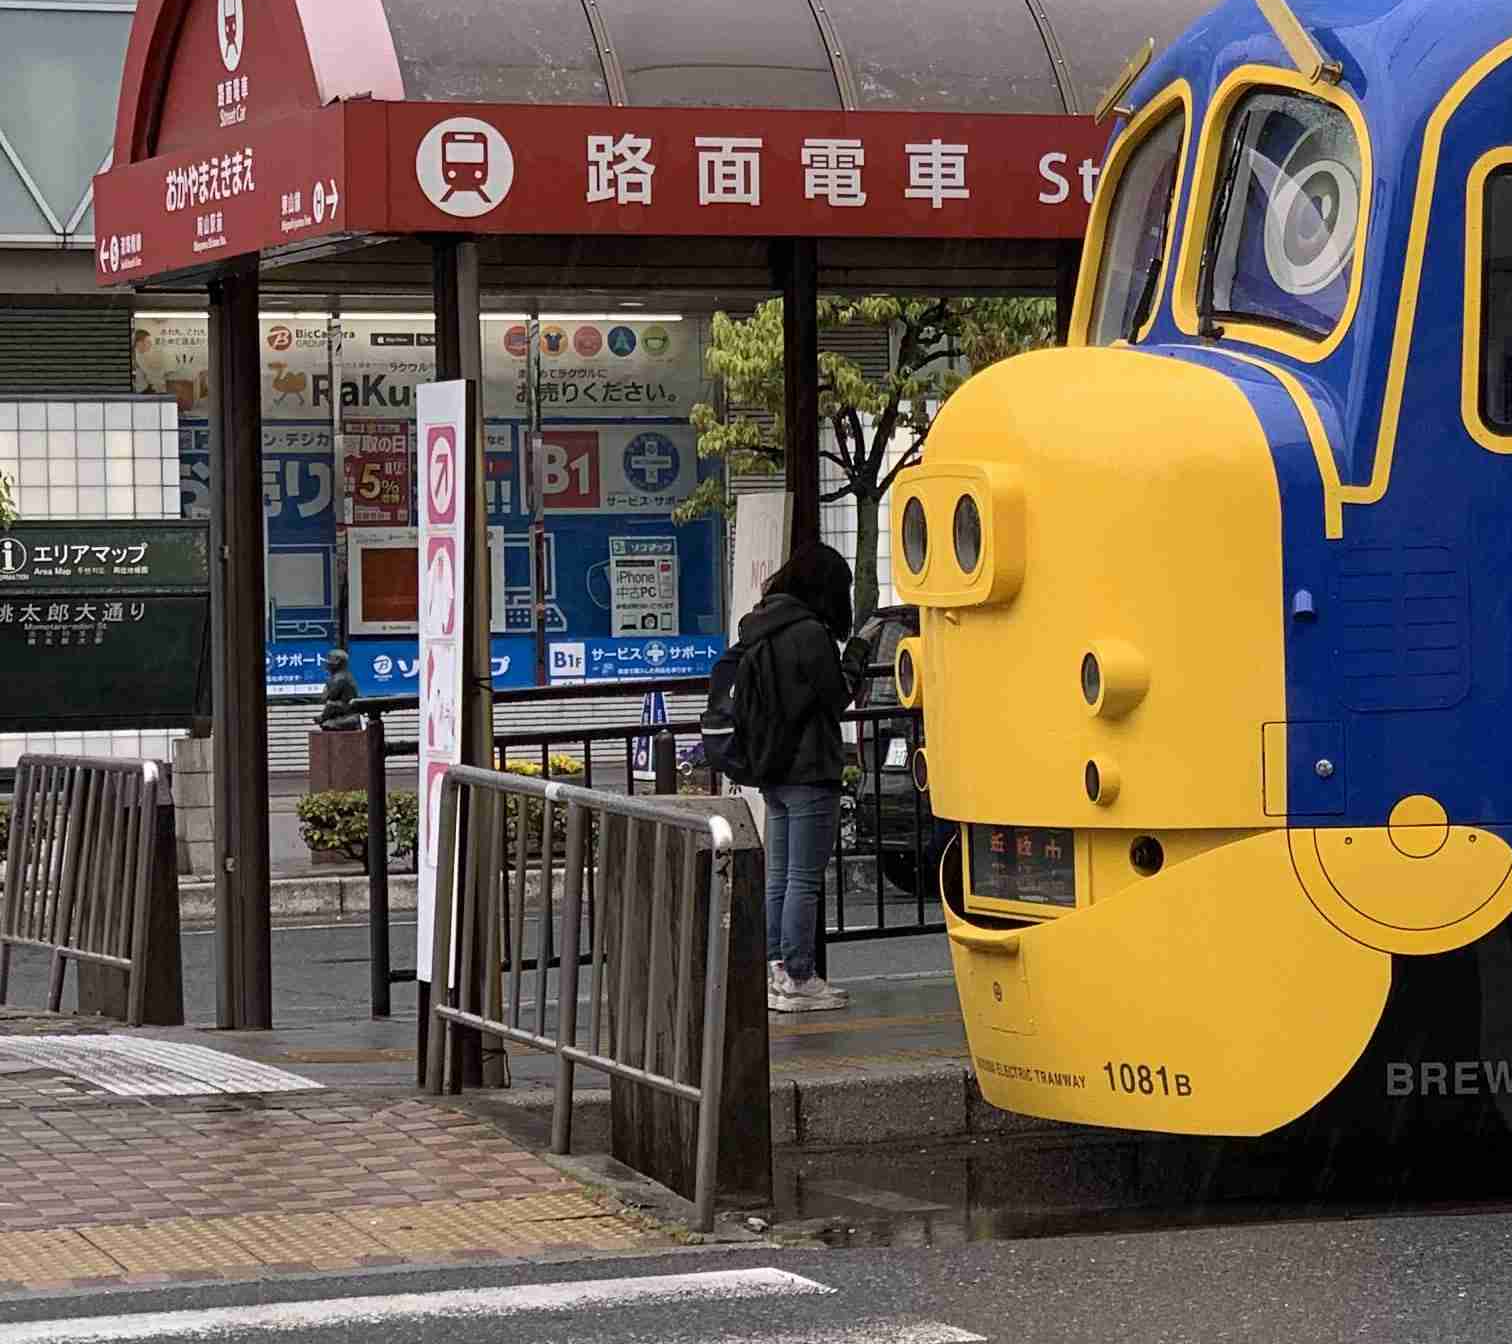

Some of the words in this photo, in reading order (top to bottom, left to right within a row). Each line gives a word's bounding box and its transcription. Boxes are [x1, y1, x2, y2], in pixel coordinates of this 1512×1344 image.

[165, 146, 255, 212] おかやまえきまえ
[586, 132, 970, 208] 路面電車
[295, 329, 355, 339] BicCara
[33, 542, 149, 565] エリアマップ
[616, 570, 656, 585] iPhone
[275, 653, 327, 668] サポート
[592, 648, 643, 662] サービス
[669, 645, 718, 661] サポート
[1034, 1068, 1088, 1089] TRAMWAY
[1103, 1061, 1193, 1097] 1081B
